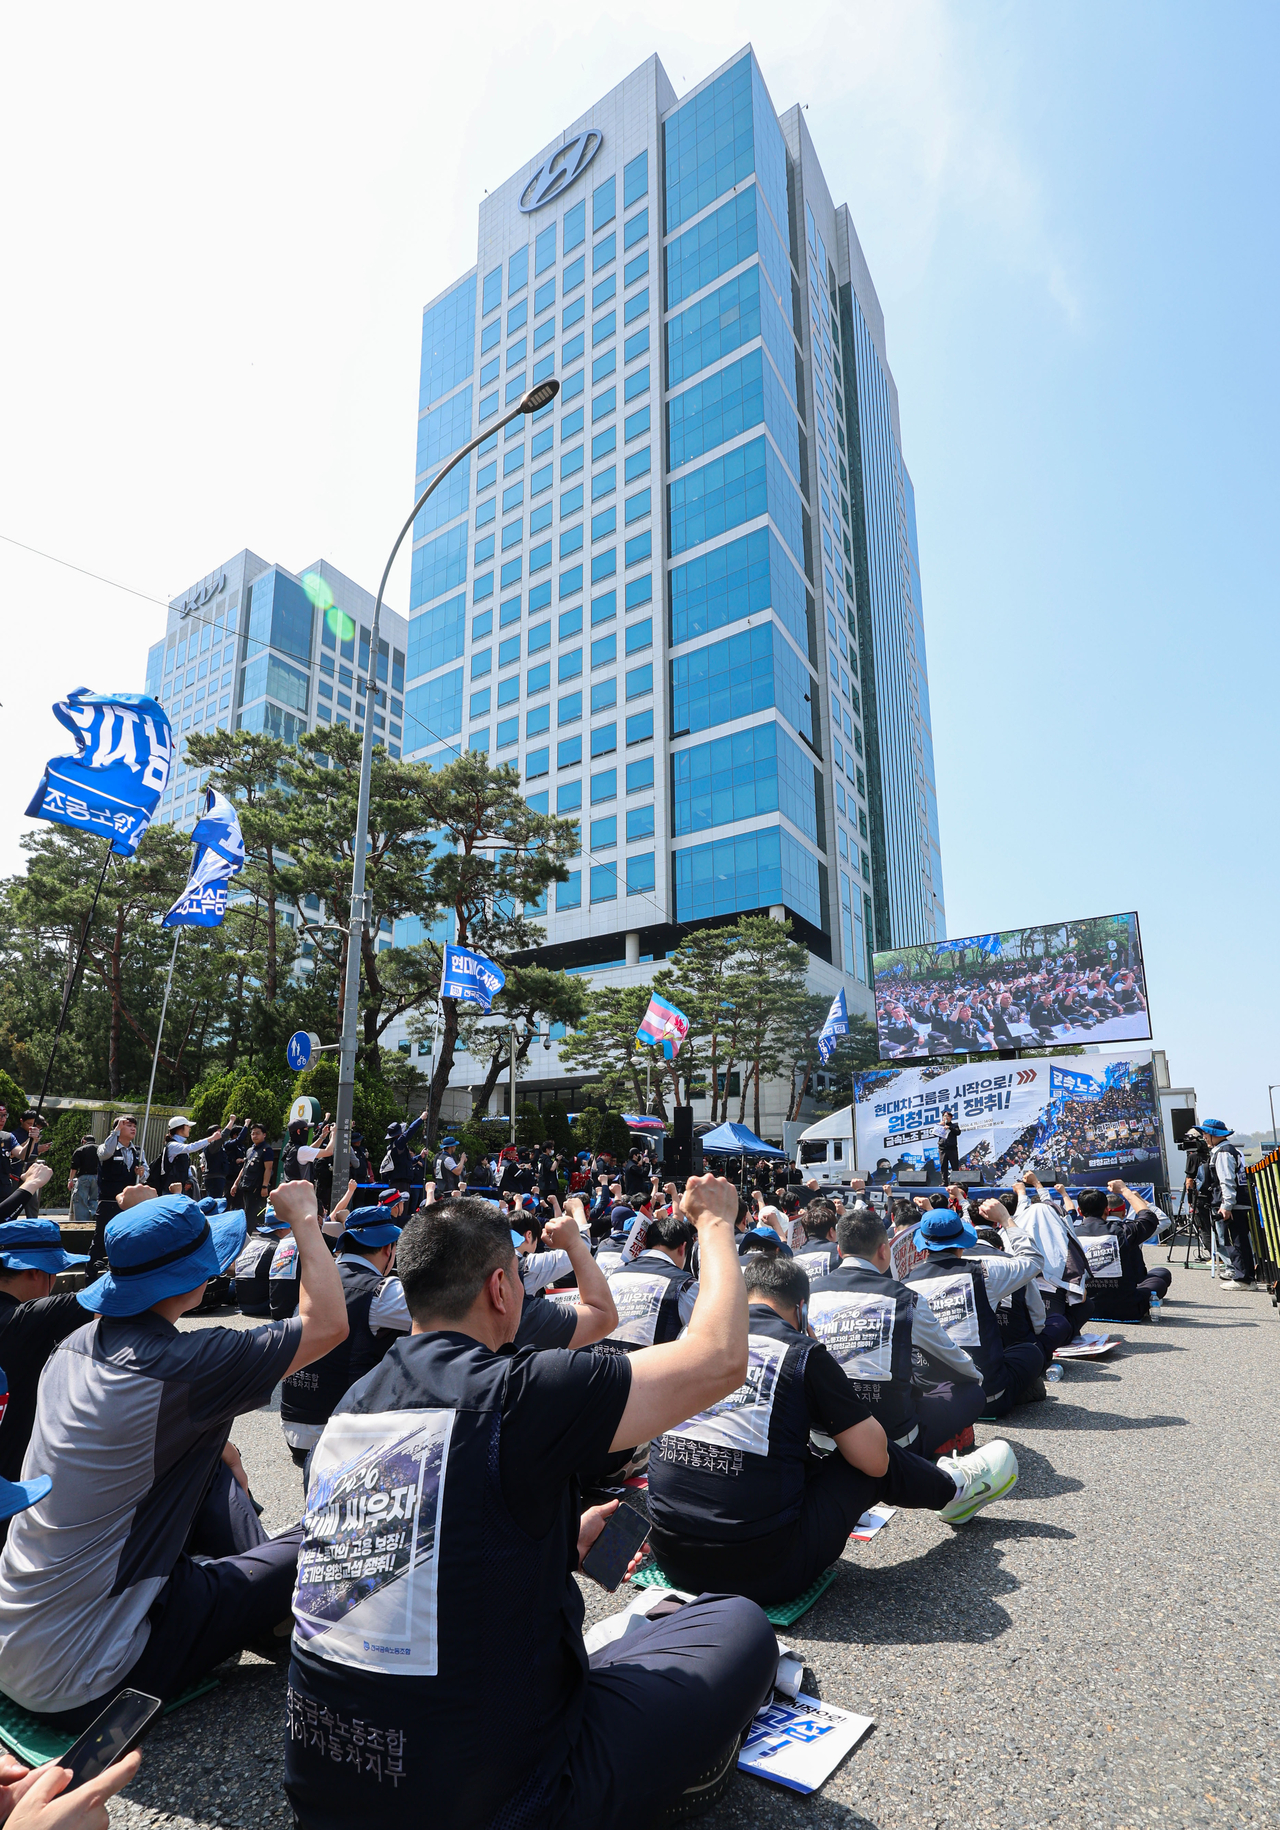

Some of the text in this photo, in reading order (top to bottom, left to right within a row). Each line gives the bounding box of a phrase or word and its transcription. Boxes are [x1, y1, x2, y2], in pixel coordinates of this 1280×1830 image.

[874, 1073, 1013, 1118] 현대차그룹을 시작으로!
[963, 1090, 1012, 1118] 쟁취!
[886, 1132, 919, 1147] 금속노조
[932, 1295, 965, 1311] 싸우자
[840, 1318, 883, 1335] 싸우자
[659, 1447, 745, 1476] 기아자동차지부
[660, 1434, 745, 1462] 전국금속노동조합
[341, 1483, 418, 1532] 싸우자
[350, 1537, 373, 1558] 고용
[375, 1532, 406, 1553] 보장!
[363, 1553, 397, 1577] 쟁취!
[370, 1644, 411, 1656] 전국금속노동조합
[286, 1685, 407, 1757] 전국금속노동조합
[286, 1708, 407, 1788] 기아자동차지부
